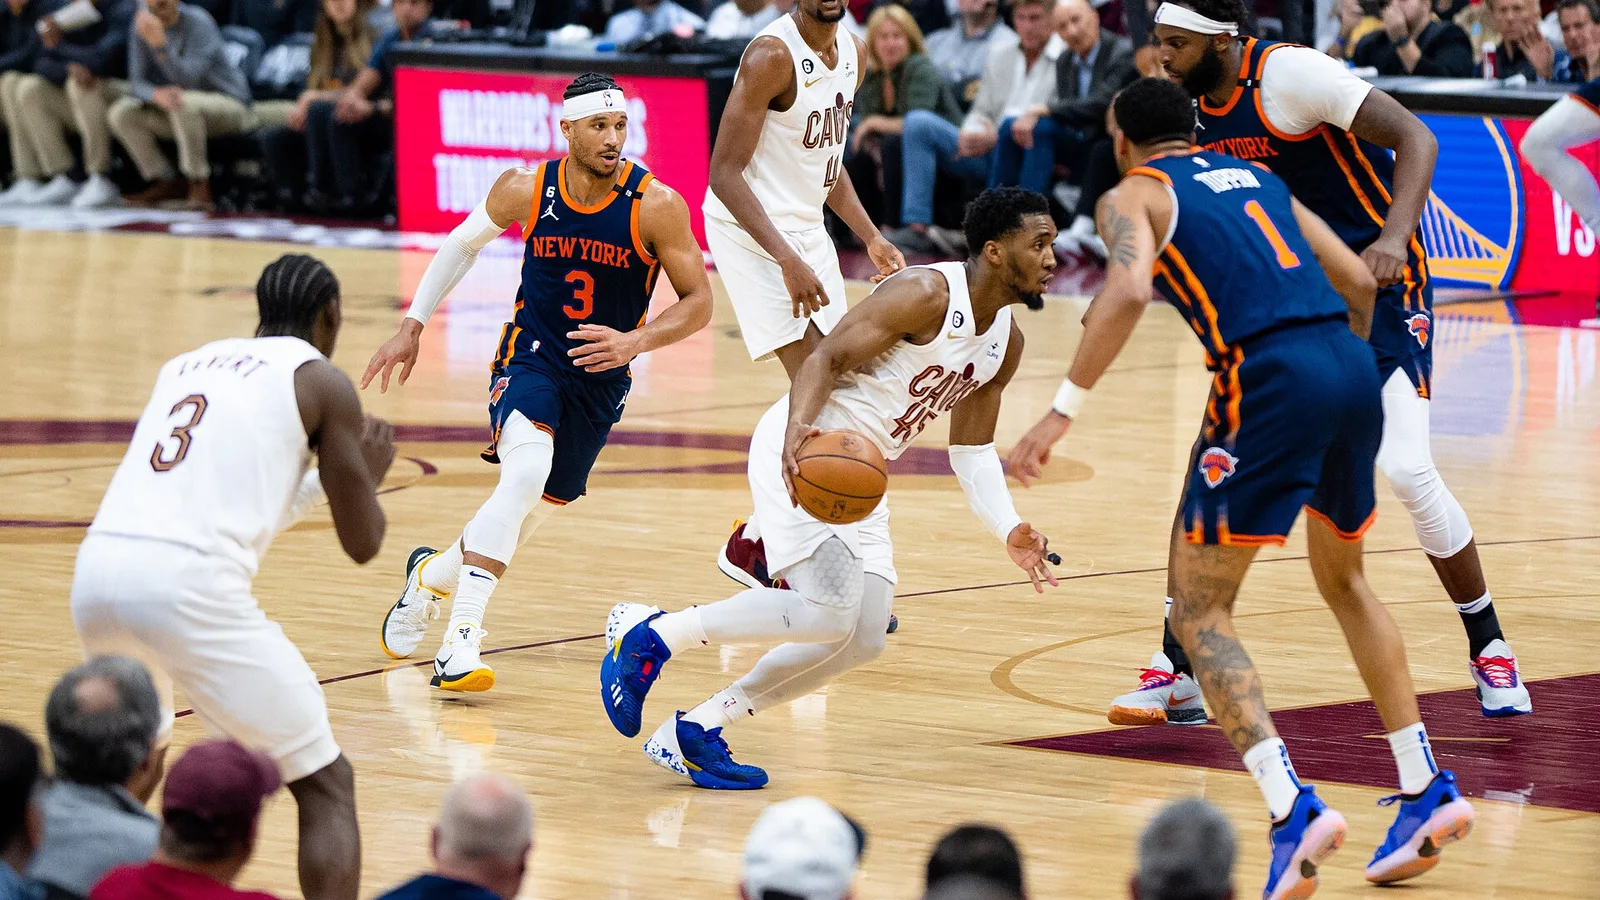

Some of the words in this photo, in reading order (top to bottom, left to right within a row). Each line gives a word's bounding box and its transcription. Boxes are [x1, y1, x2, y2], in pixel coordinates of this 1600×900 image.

[803, 60, 813, 73] 6
[1225, 137, 1279, 160] YORK
[545, 186, 555, 198] 6
[1244, 200, 1300, 269] 1
[532, 236, 577, 258] NEW
[579, 238, 631, 268] YORK
[562, 269, 594, 320] 3
[953, 312, 963, 327] 6
[908, 365, 979, 412] CAVS
[150, 394, 208, 472] 3
